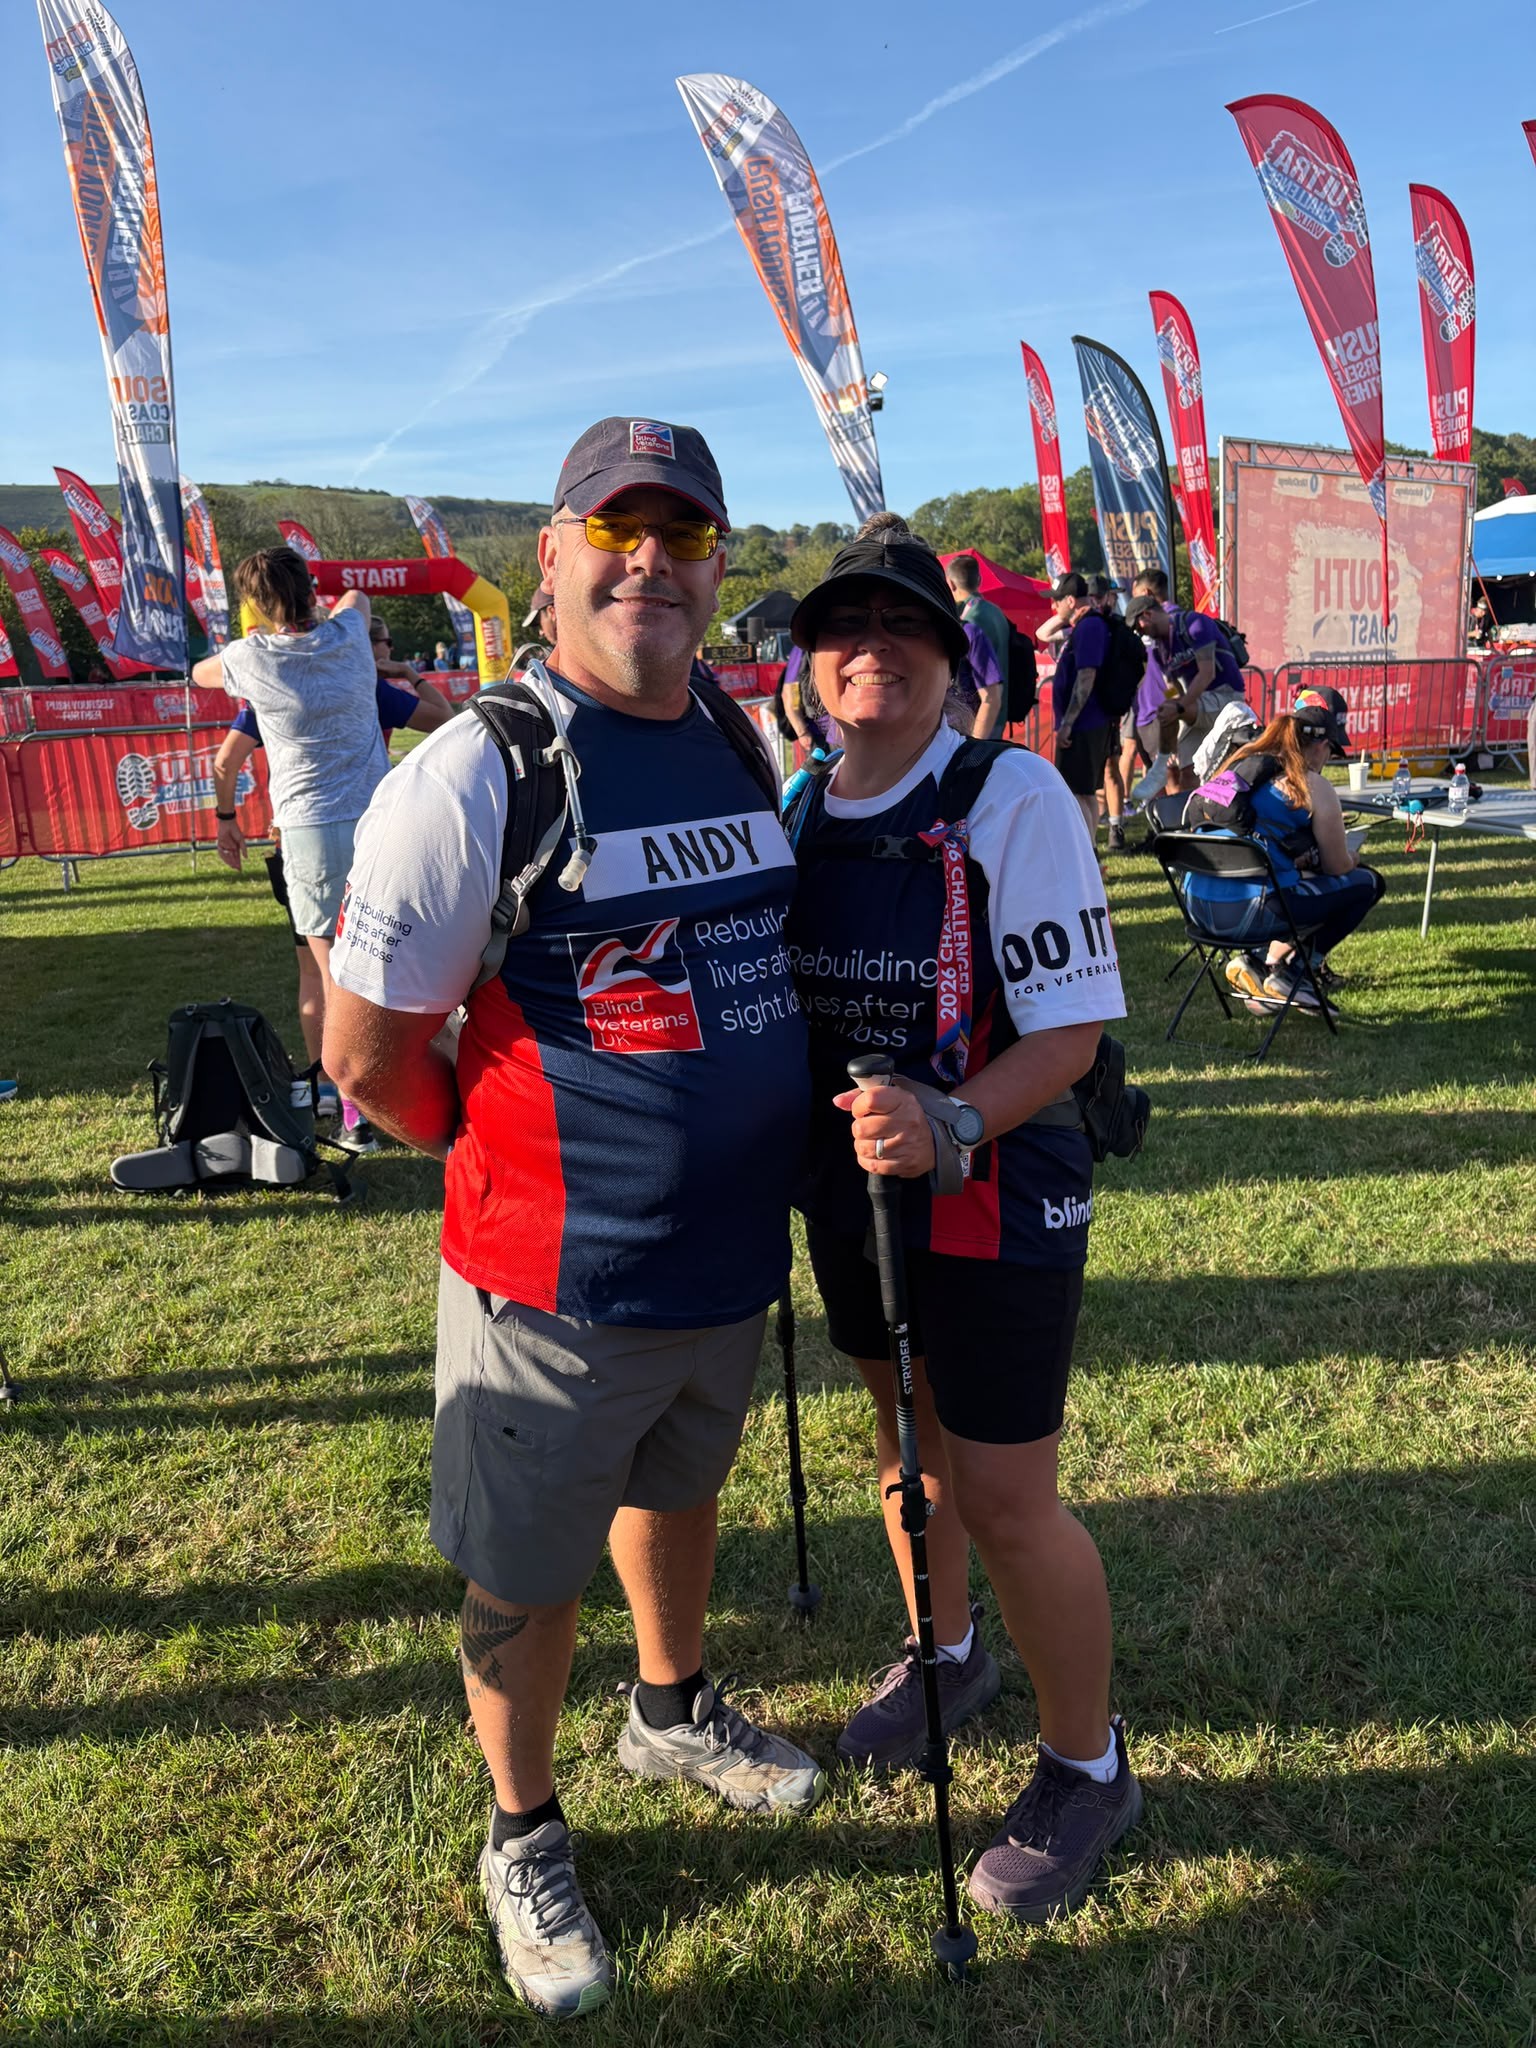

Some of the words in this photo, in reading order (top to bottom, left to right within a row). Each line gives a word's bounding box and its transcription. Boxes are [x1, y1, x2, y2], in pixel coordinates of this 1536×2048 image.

[341, 567, 408, 588] START
[641, 820, 760, 884] ANDY
[354, 896, 412, 937] Rebuilding
[695, 905, 789, 947] Rebuil
[368, 942, 394, 963] loss
[371, 928, 402, 947] after
[1001, 921, 1071, 983] DO
[1079, 906, 1108, 958] IT
[707, 957, 768, 988] lives
[787, 946, 938, 988] Rebuilding
[1014, 982, 1045, 999] FOR
[1054, 961, 1117, 987] VETERANS
[593, 995, 644, 1016] Blind
[844, 995, 925, 1021] after
[940, 966, 958, 1020] 2026
[594, 1011, 689, 1032] Veterans
[721, 993, 785, 1034] sight
[601, 1032, 631, 1047] UK
[1042, 1189, 1094, 1229] blind
[899, 1338, 914, 1395] STRYDER
